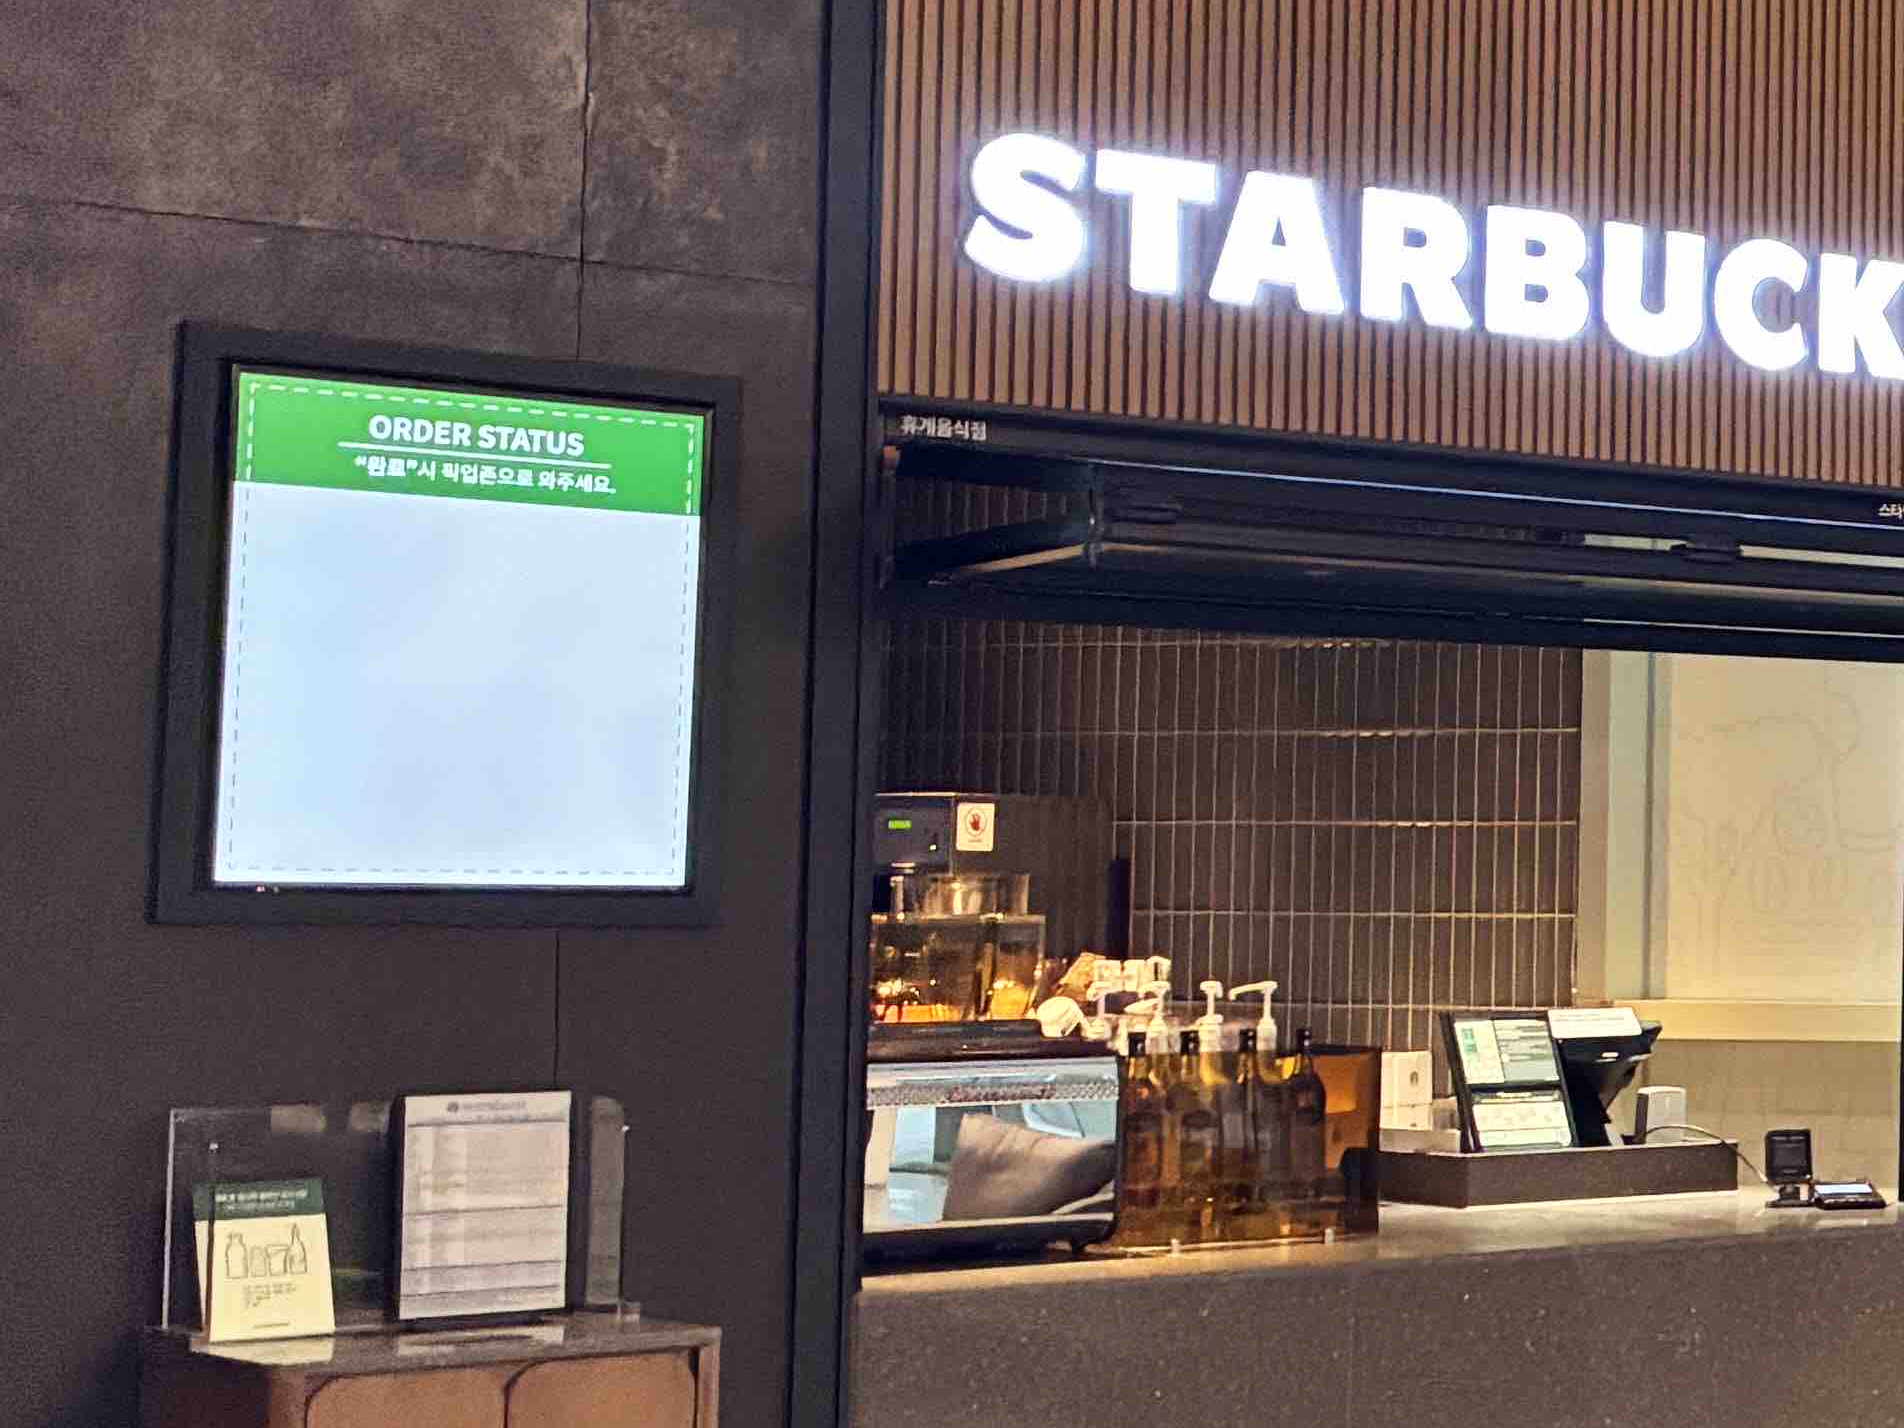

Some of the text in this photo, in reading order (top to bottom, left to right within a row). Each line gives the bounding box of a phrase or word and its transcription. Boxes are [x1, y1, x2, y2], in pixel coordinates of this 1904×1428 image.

[368, 415, 585, 457] ORDER STATUS
[901, 415, 987, 441] 휴게음식점
